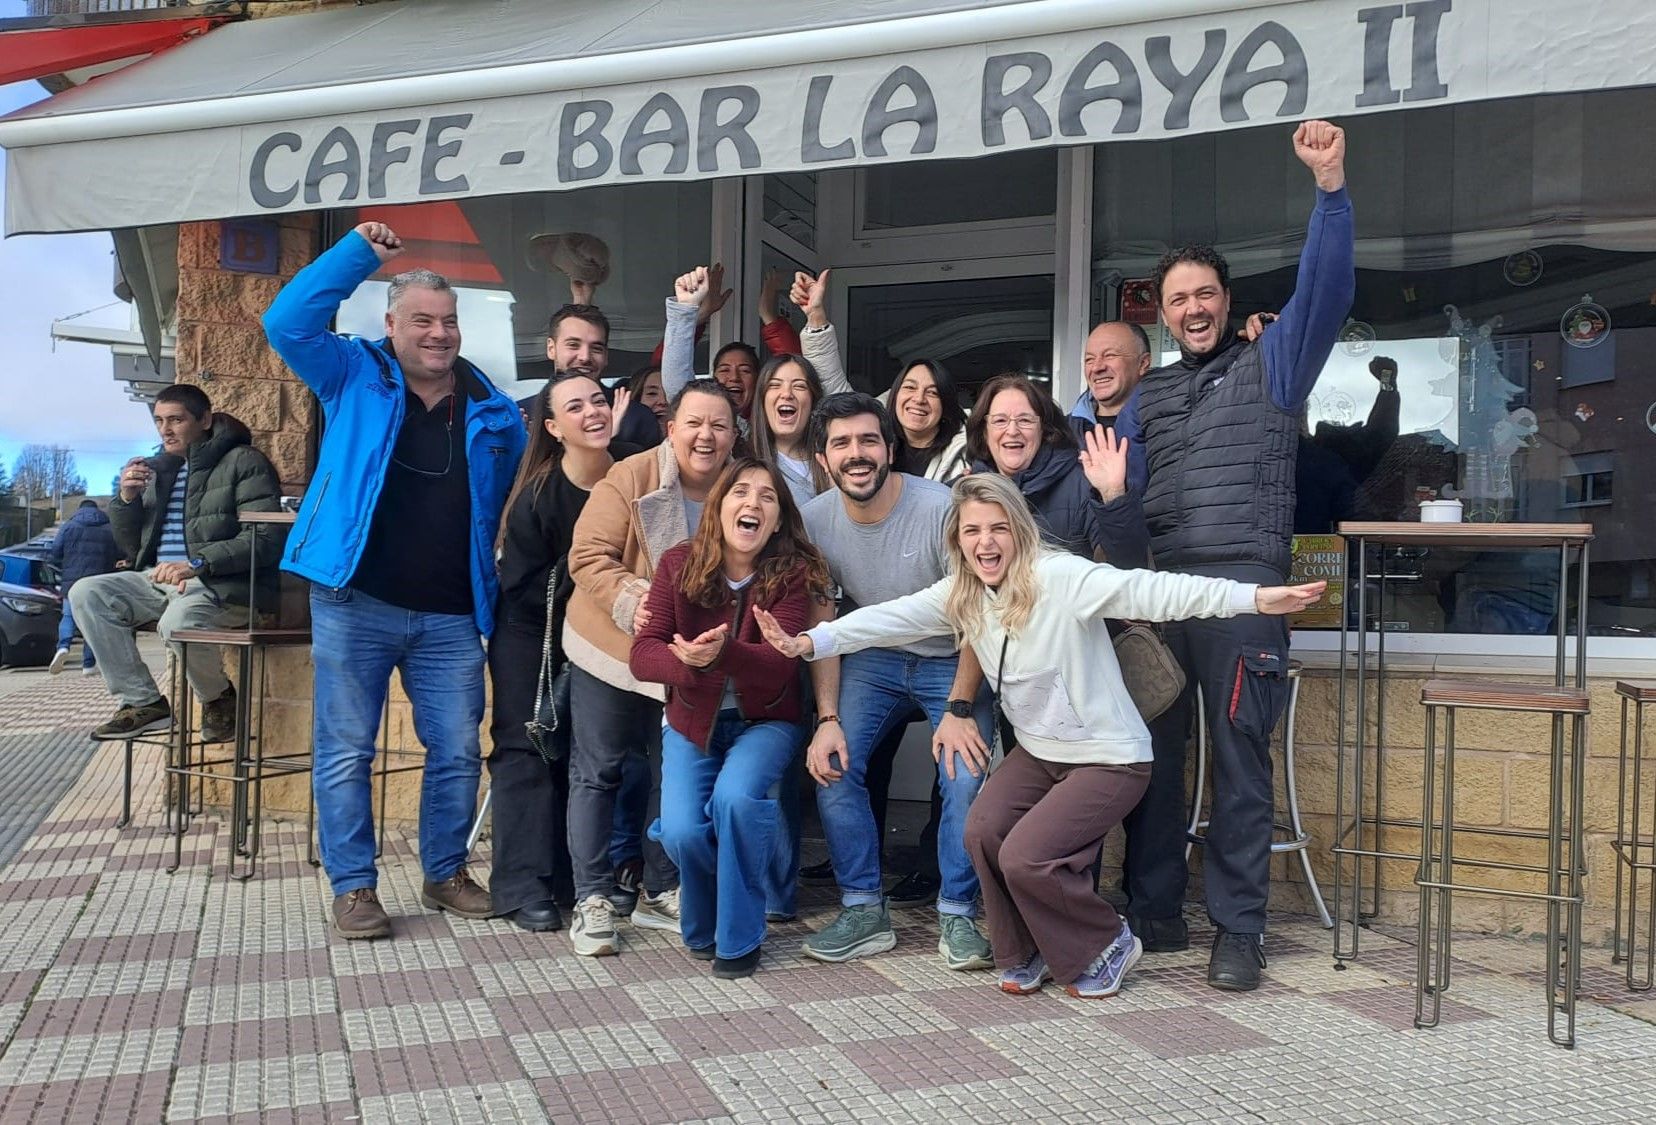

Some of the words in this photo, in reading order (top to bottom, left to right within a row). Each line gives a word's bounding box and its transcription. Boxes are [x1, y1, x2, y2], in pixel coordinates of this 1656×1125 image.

[249, 113, 473, 208] CAFE
[557, 85, 762, 183] BAR
[801, 65, 939, 163] LA
[981, 20, 1310, 147] RAYA
[1355, 0, 1452, 107] II
